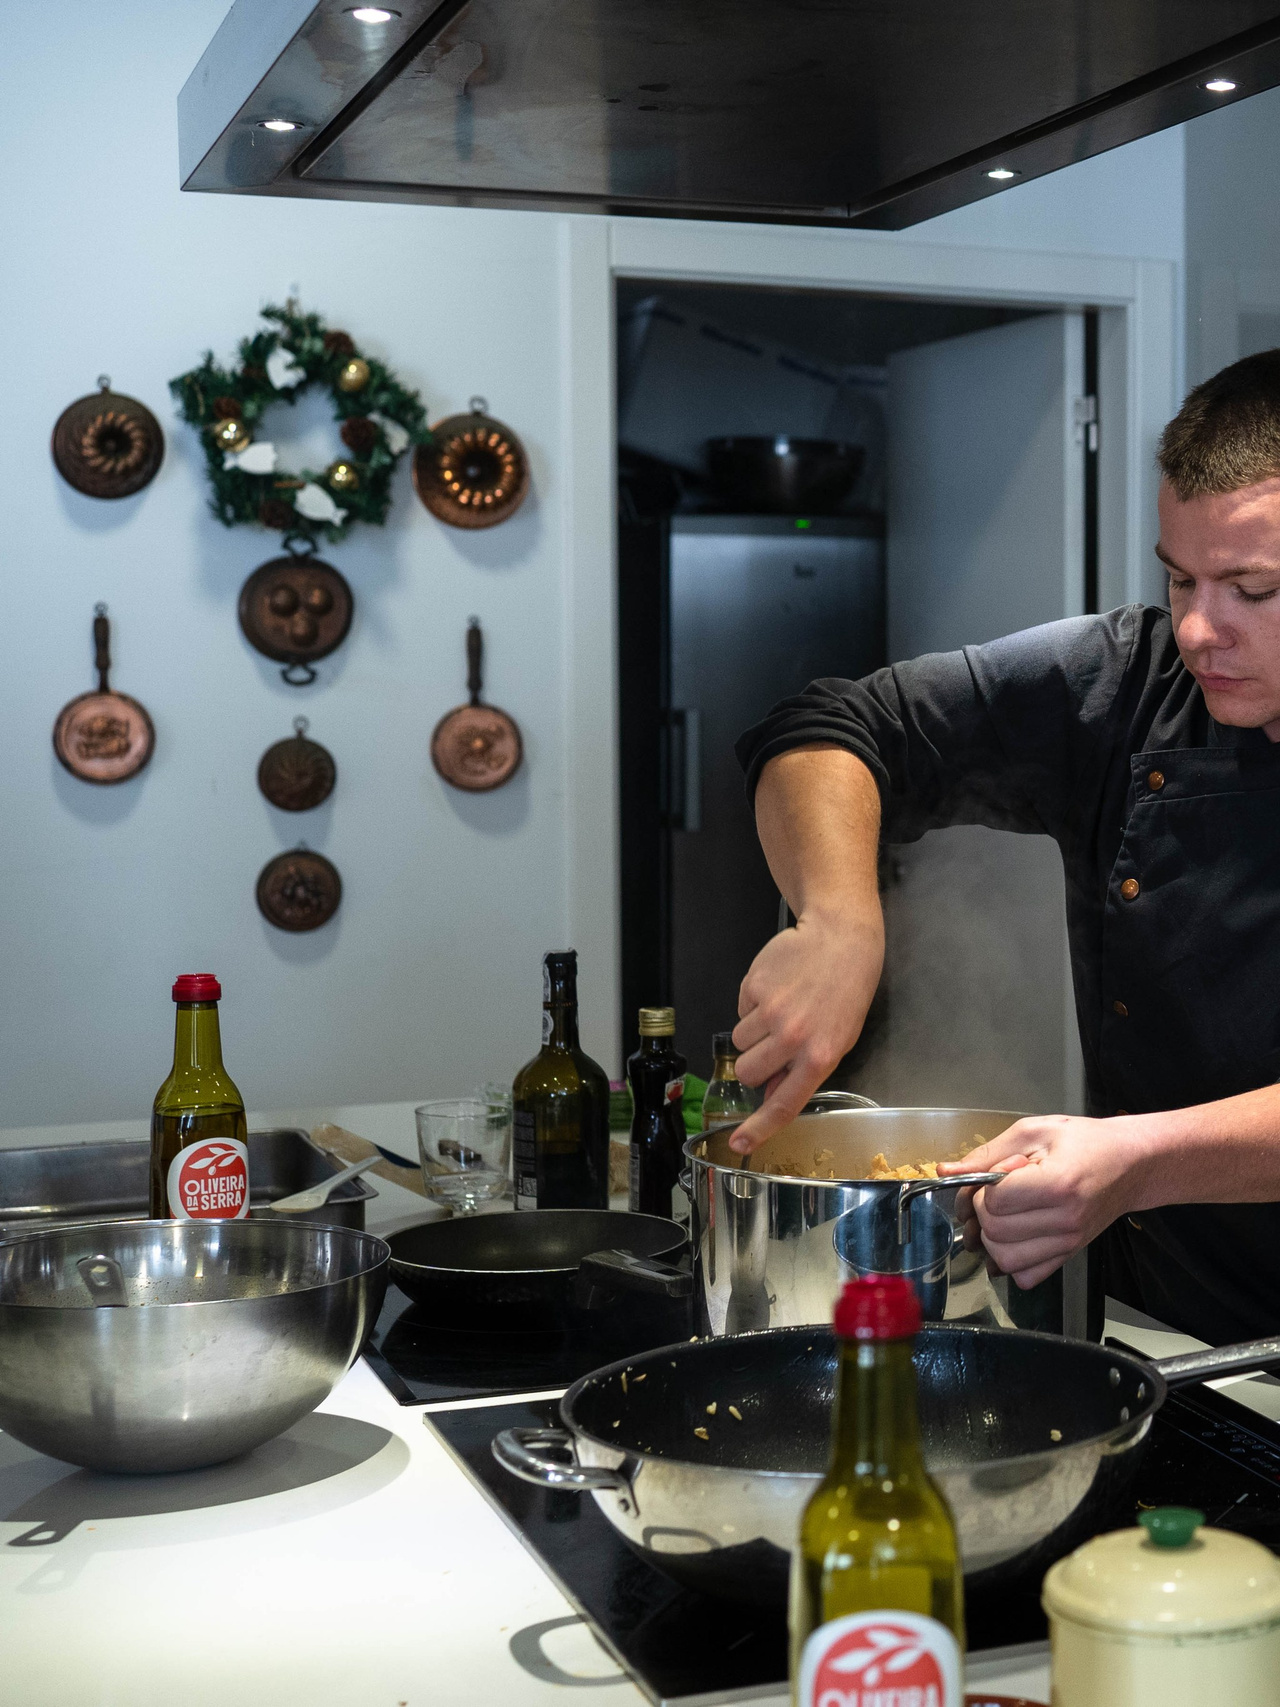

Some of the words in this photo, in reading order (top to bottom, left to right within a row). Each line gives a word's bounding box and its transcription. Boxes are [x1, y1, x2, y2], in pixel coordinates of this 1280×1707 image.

[184, 1174, 245, 1196] OLIVEIRA
[187, 1196, 199, 1207] DA
[201, 1190, 242, 1211] SERRA
